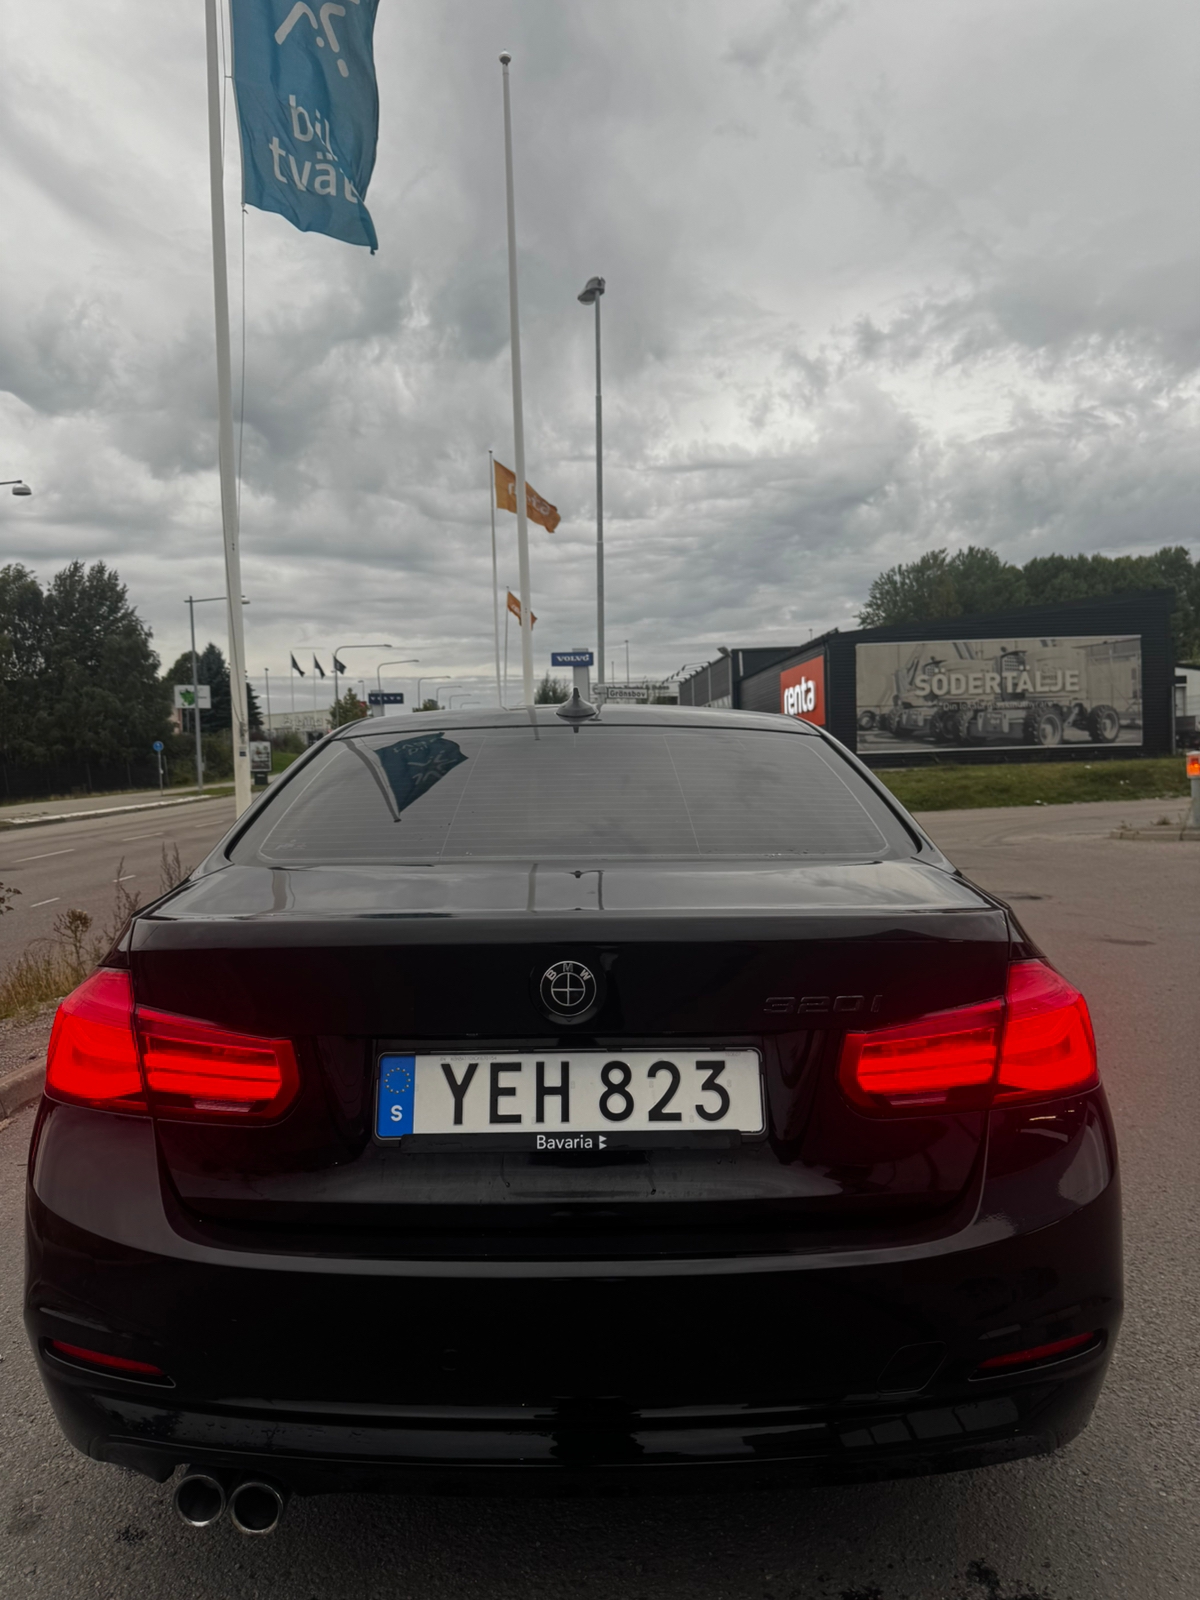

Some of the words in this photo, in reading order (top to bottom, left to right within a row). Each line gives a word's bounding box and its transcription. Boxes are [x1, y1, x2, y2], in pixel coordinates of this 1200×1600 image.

[288, 94, 337, 161] bil
[556, 654, 590, 662] VOLVO
[914, 665, 1080, 697] SÖDERTÄLJE
[783, 675, 815, 716] renta
[545, 962, 592, 982] BMW
[440, 1060, 571, 1126] YEH
[598, 1059, 732, 1123] 823
[390, 1106, 403, 1123] S
[536, 1134, 594, 1151] Bavaria
